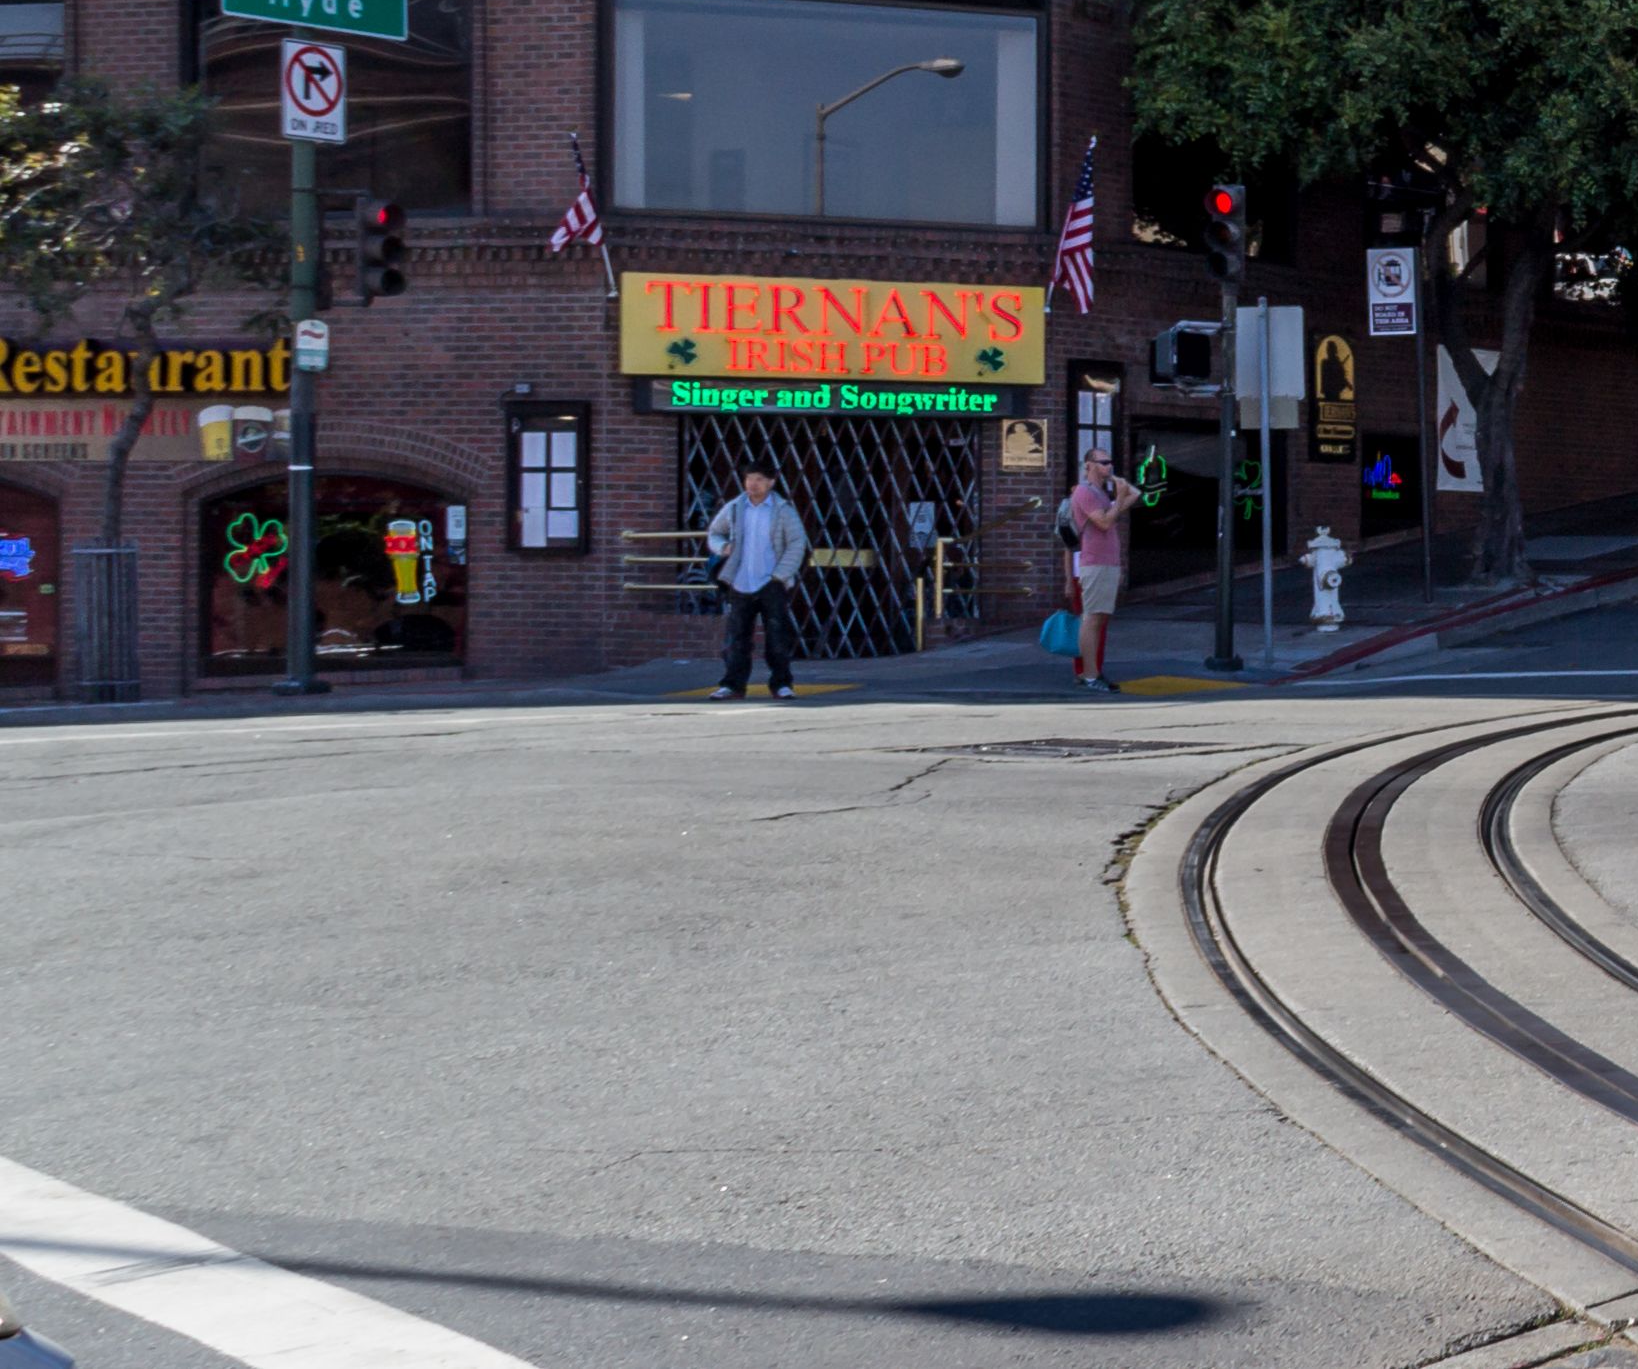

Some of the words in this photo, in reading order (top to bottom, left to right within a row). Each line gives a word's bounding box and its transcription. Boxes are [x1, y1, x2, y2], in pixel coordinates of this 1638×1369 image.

[290, 117, 308, 131] ON
[645, 279, 1025, 343] TIERNAN'S
[726, 336, 850, 374] IRISH
[860, 342, 948, 377] PUB
[671, 381, 768, 413] Singer
[776, 384, 831, 410] and
[840, 384, 998, 415] Songwriter
